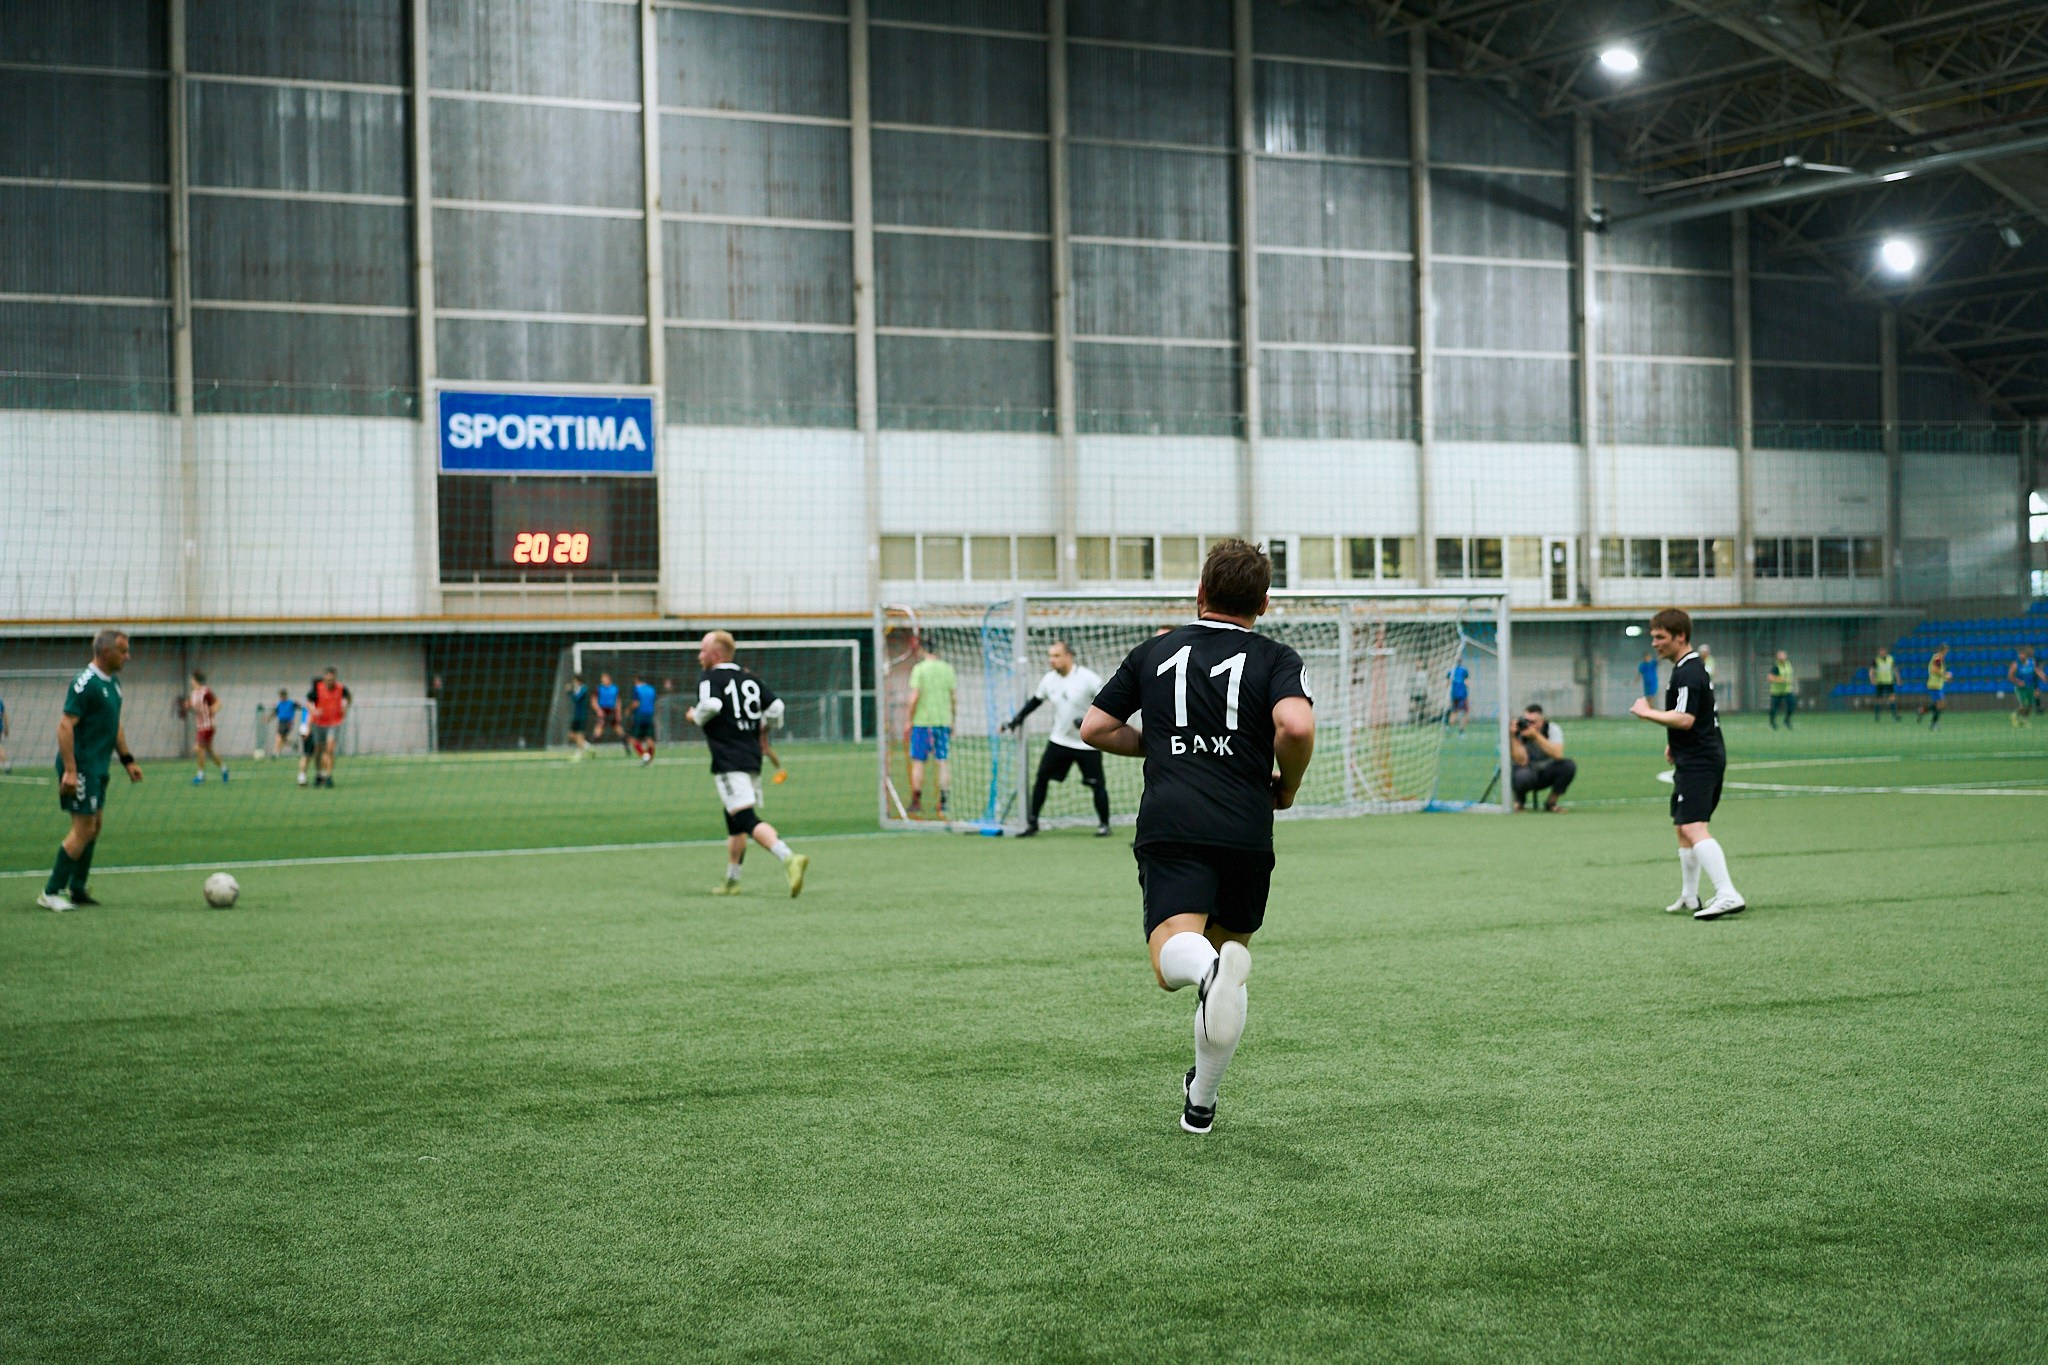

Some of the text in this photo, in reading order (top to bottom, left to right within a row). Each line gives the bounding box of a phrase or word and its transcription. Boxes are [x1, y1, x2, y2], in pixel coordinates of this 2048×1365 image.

[448, 413, 646, 451] SPORTIMA
[724, 678, 762, 720] 18
[1156, 645, 1247, 730] 11
[1170, 734, 1234, 756] БАЖ
